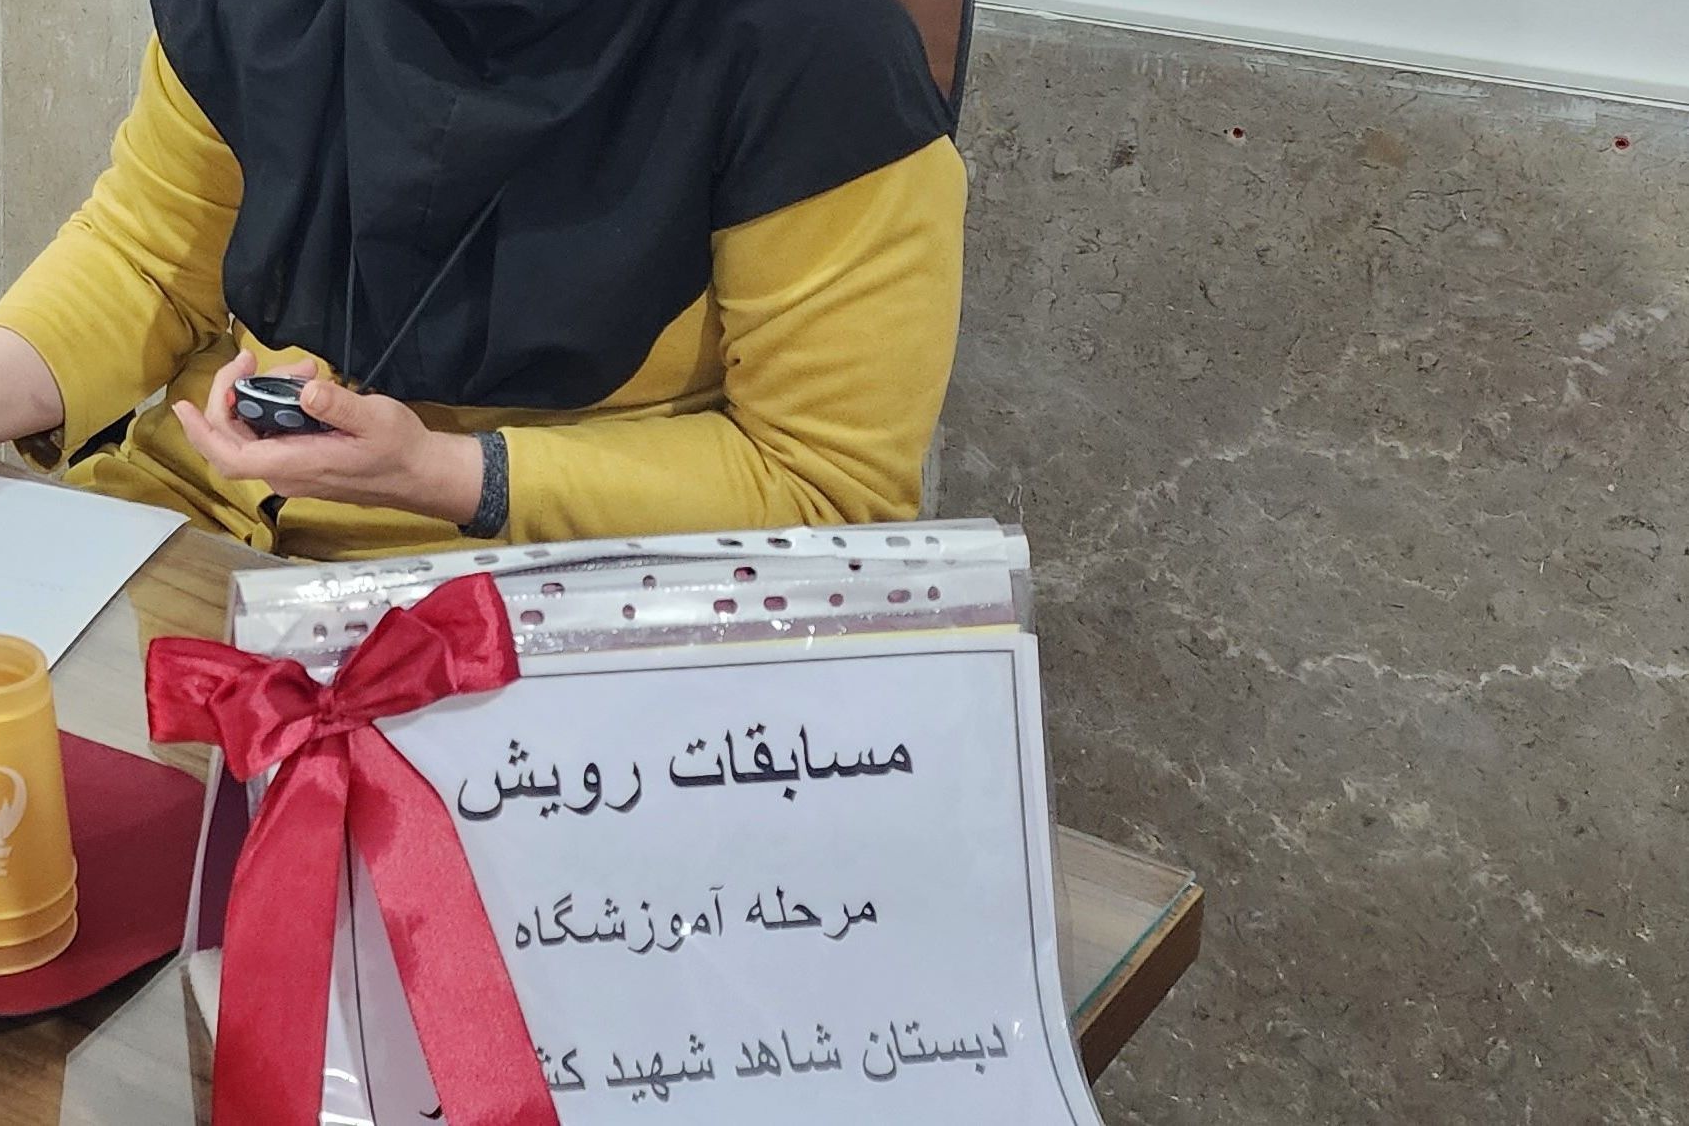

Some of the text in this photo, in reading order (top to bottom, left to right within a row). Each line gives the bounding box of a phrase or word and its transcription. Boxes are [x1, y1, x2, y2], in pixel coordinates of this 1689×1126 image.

[456, 722, 914, 822] مسابقات رویش
[513, 884, 878, 954] مرحله آموزشگاه
[605, 1031, 715, 1102] شهید
[733, 1023, 842, 1079] شاهد
[860, 1019, 1008, 1082] دبستان
